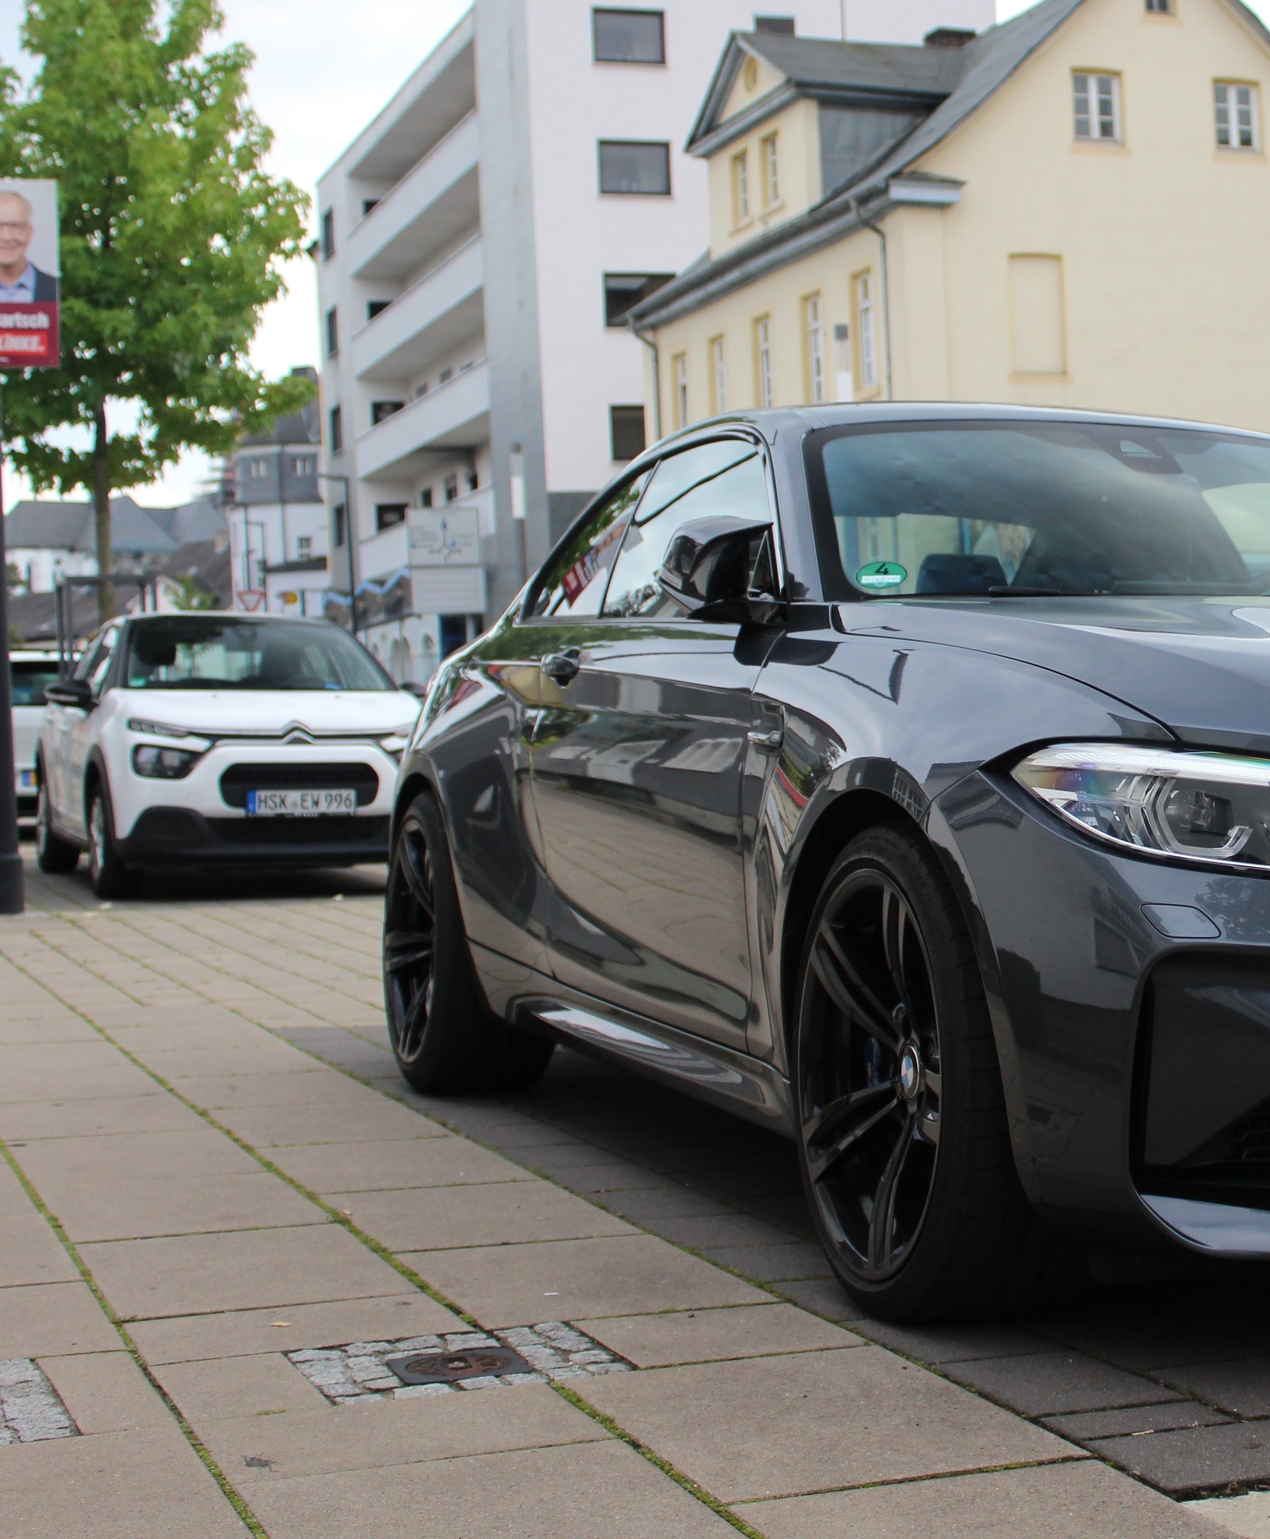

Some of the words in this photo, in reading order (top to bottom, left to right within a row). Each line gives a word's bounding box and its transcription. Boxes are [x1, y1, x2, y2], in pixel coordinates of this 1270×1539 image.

[0, 311, 50, 329] artsch
[875, 563, 889, 575] 4
[257, 794, 287, 810] HSK
[300, 793, 319, 809] EW
[324, 793, 352, 808] 996
